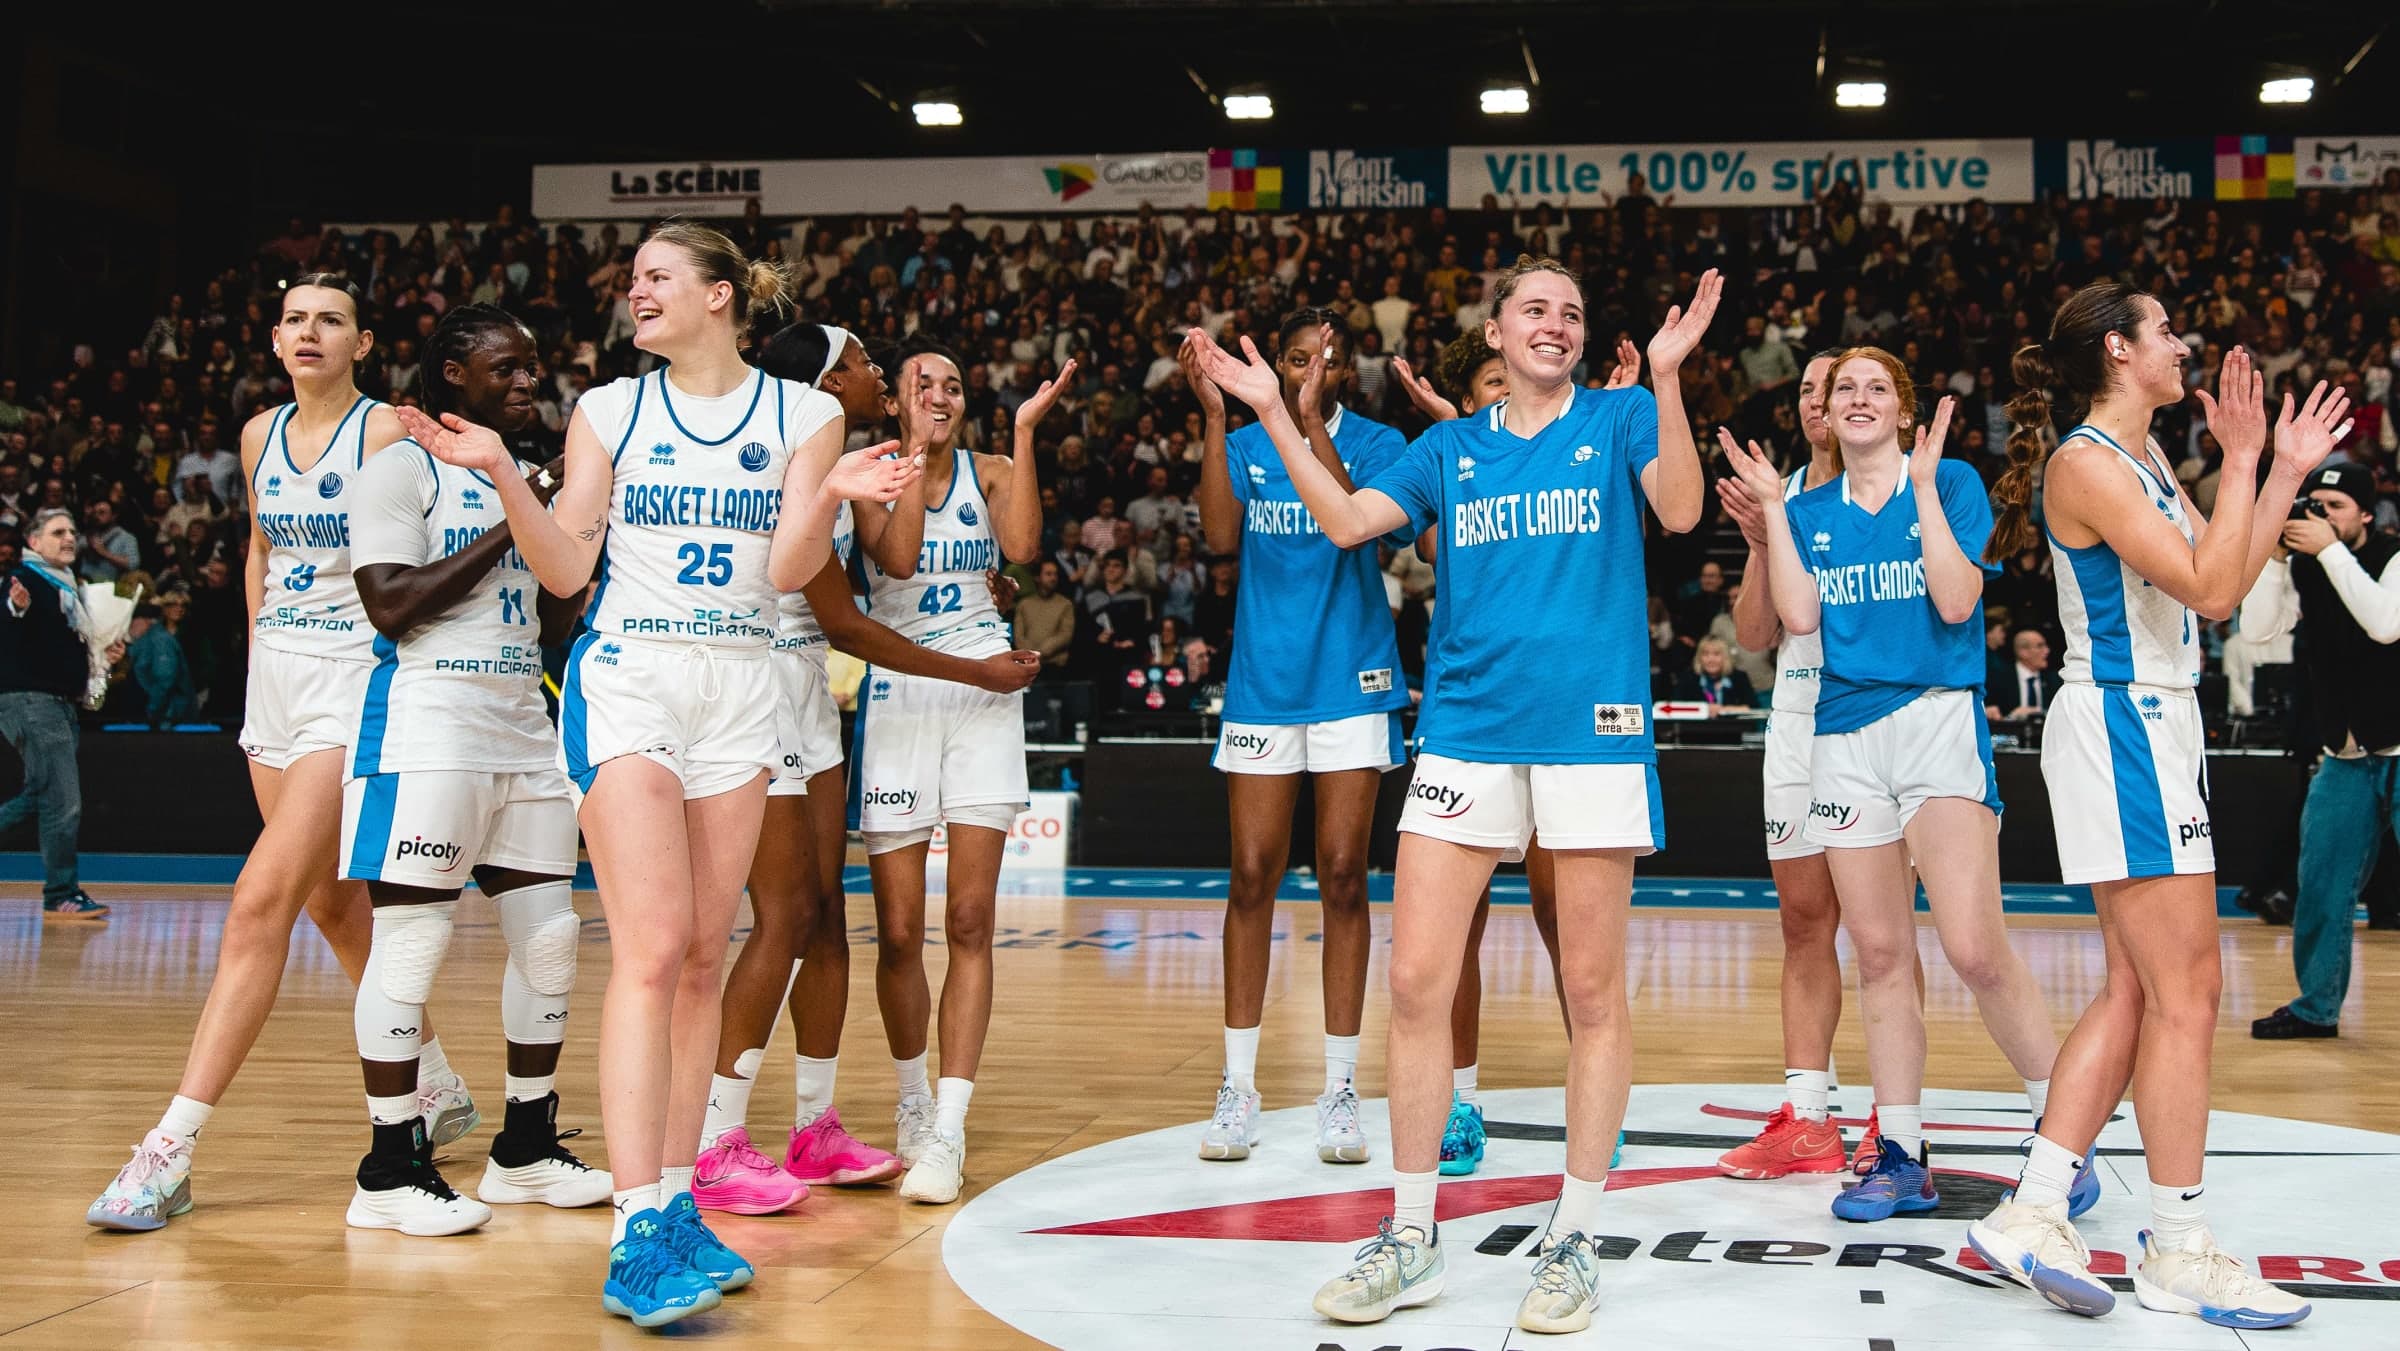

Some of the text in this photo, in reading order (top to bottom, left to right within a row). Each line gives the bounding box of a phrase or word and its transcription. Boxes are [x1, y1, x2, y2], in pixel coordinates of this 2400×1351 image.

[611, 171, 649, 195] La
[1485, 148, 1990, 199] Ville 100% sportive
[649, 456, 676, 466] errea
[463, 501, 484, 510] errea
[624, 484, 782, 531] BASKET LANDES
[1248, 498, 1303, 535] BASKET
[1455, 487, 1601, 547] BASKET LANDES
[298, 512, 350, 549] LANDE
[676, 542, 734, 586] 25
[943, 537, 995, 572] LANDES
[498, 586, 528, 626] 11
[918, 582, 964, 615] 42
[622, 616, 775, 639] PARTICIPATION
[501, 645, 522, 660] GC
[594, 654, 618, 666] errea
[1596, 724, 1622, 734] errea
[864, 786, 918, 810] picoty
[1765, 818, 1787, 840] oty
[396, 835, 462, 866] picoty
